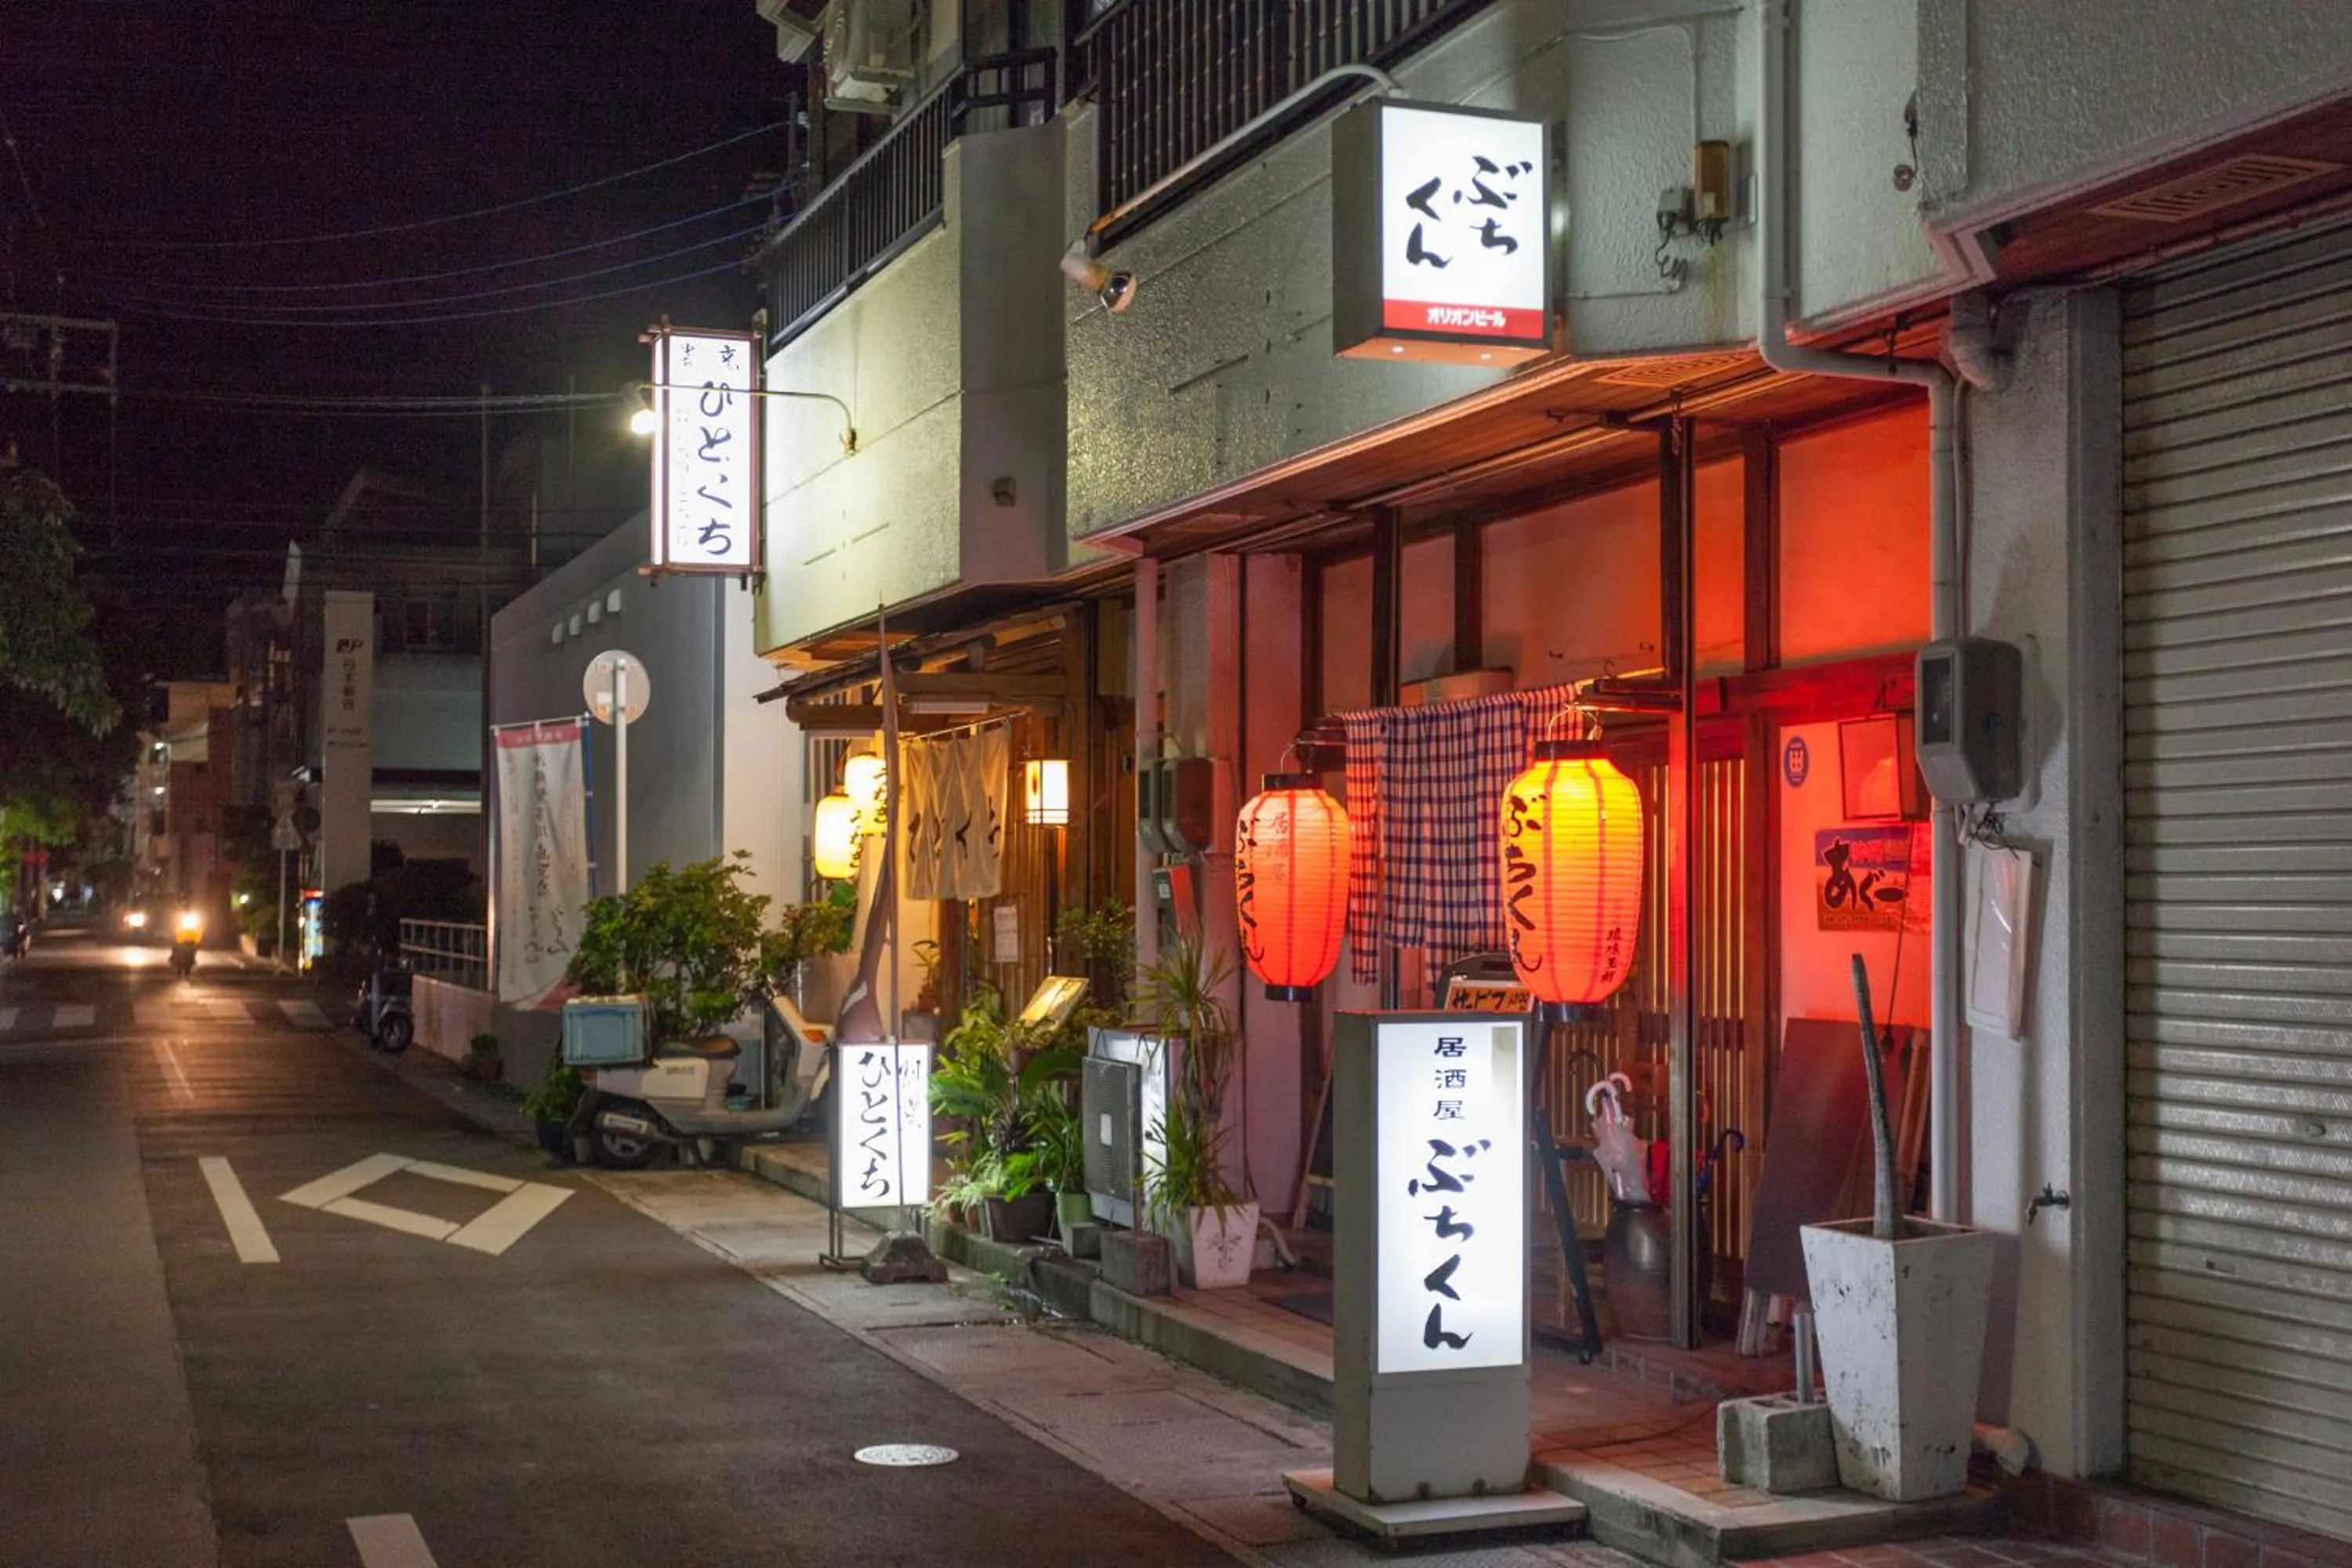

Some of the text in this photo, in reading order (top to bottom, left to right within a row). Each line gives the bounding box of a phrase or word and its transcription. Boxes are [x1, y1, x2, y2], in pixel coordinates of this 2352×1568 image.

[1427, 307, 1505, 328] オリオンビール
[858, 1051, 891, 1199] ひとくち
[1434, 1037, 1467, 1120] 居酒屋
[1408, 1139, 1490, 1349] ぶちくん
